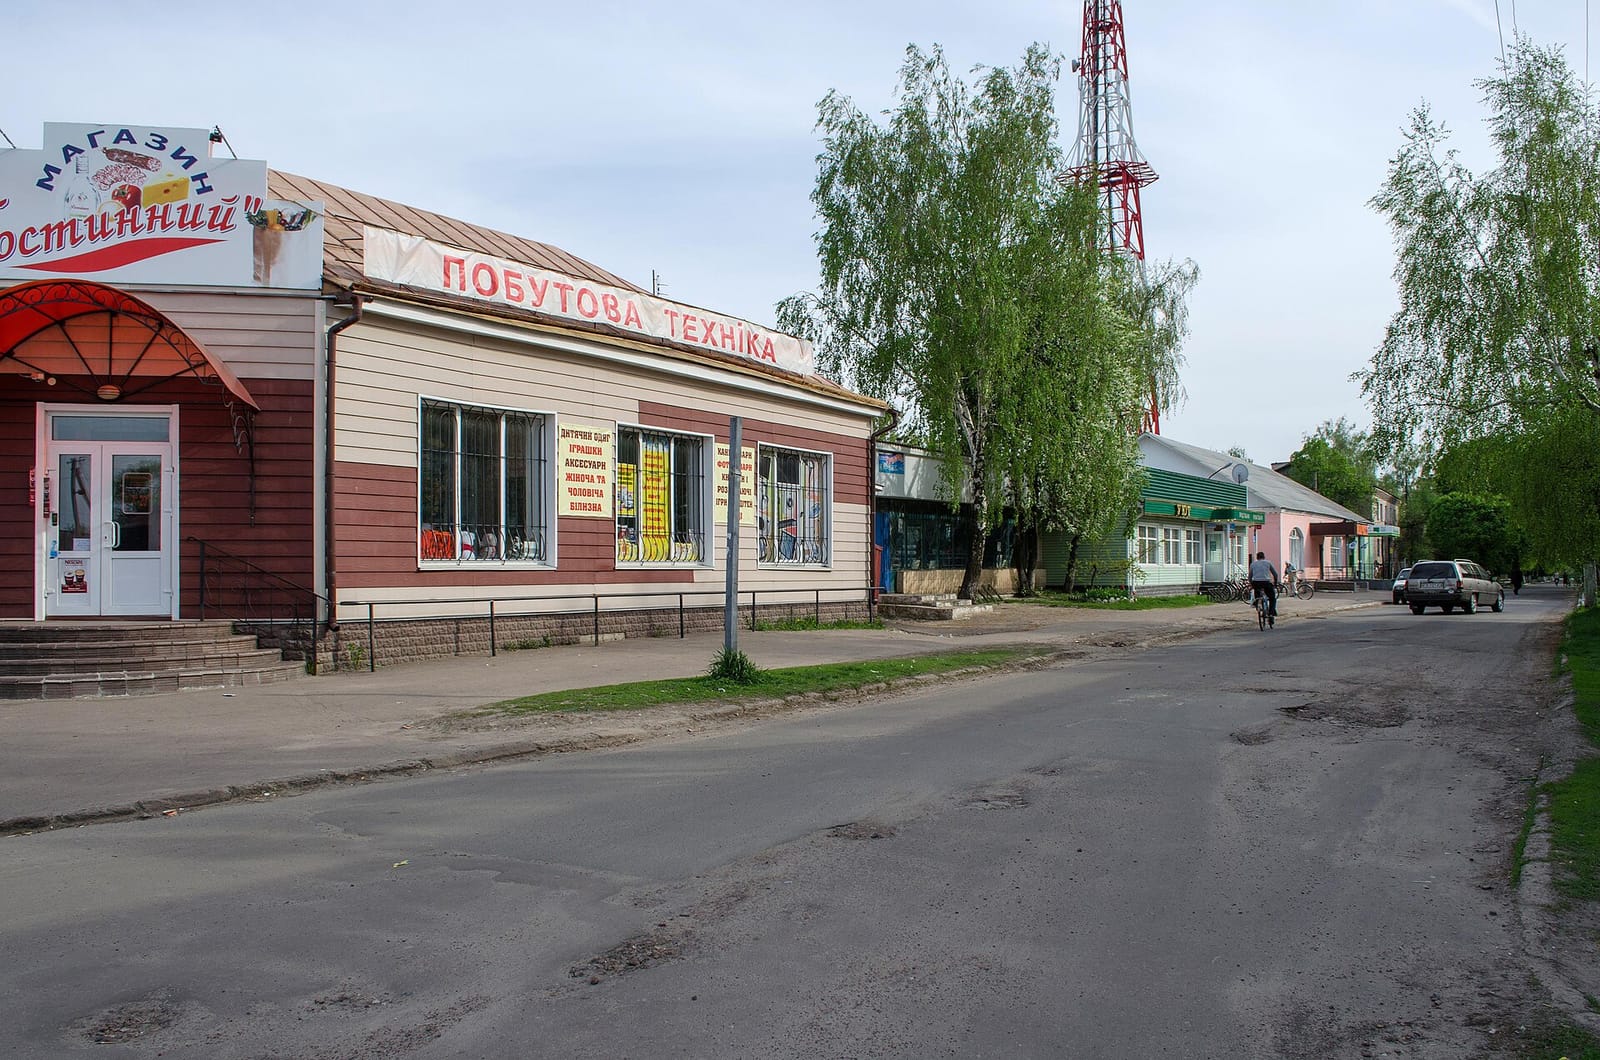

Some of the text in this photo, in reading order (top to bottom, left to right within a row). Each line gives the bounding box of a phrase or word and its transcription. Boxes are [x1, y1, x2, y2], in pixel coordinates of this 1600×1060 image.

[36, 129, 214, 196] МАГАЗИН
[0, 195, 262, 261] остинний"
[442, 254, 777, 364] ПОБУТОВА ТЕХНІКА
[565, 472, 595, 484] ЖІНОЧА
[596, 475, 606, 484] ТА
[568, 487, 604, 498] ЧОЛОВІЧА
[570, 502, 602, 512] БІЛИЗНА
